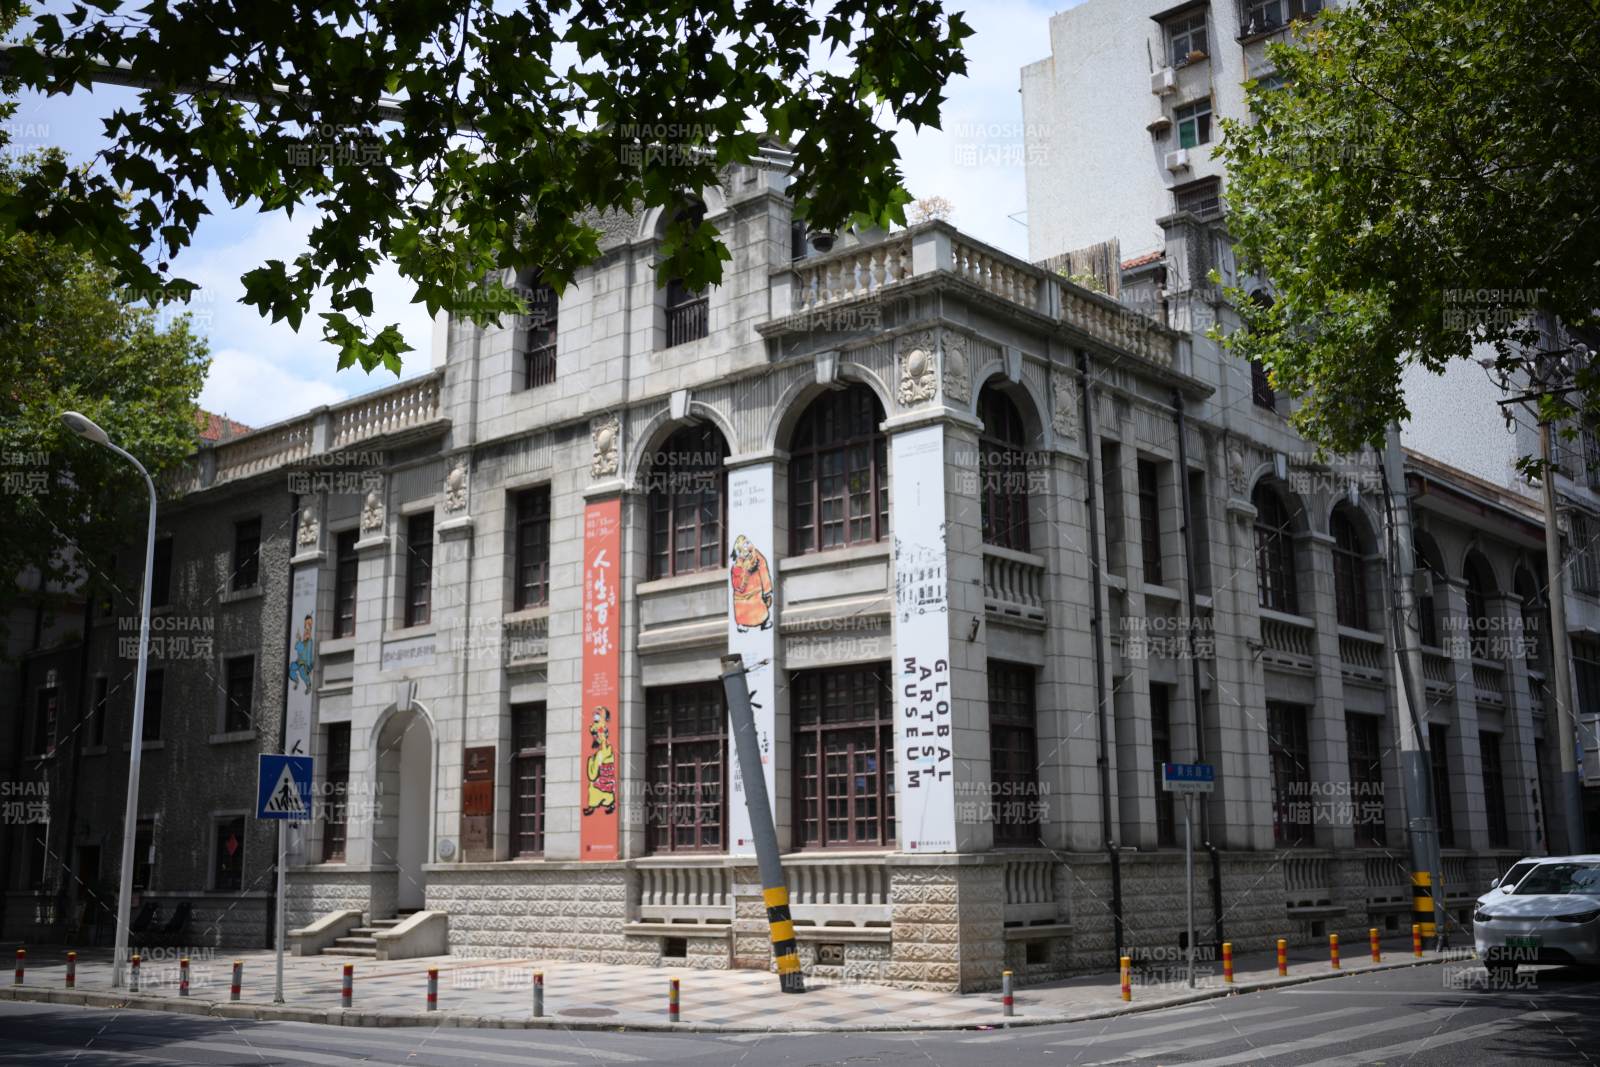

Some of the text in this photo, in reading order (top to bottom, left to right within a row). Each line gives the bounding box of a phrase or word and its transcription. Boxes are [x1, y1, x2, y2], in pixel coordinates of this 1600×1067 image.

[904, 657, 920, 788] MUSEUM
[920, 665, 936, 777] ARTIST
[935, 660, 951, 782] GLOBAL
